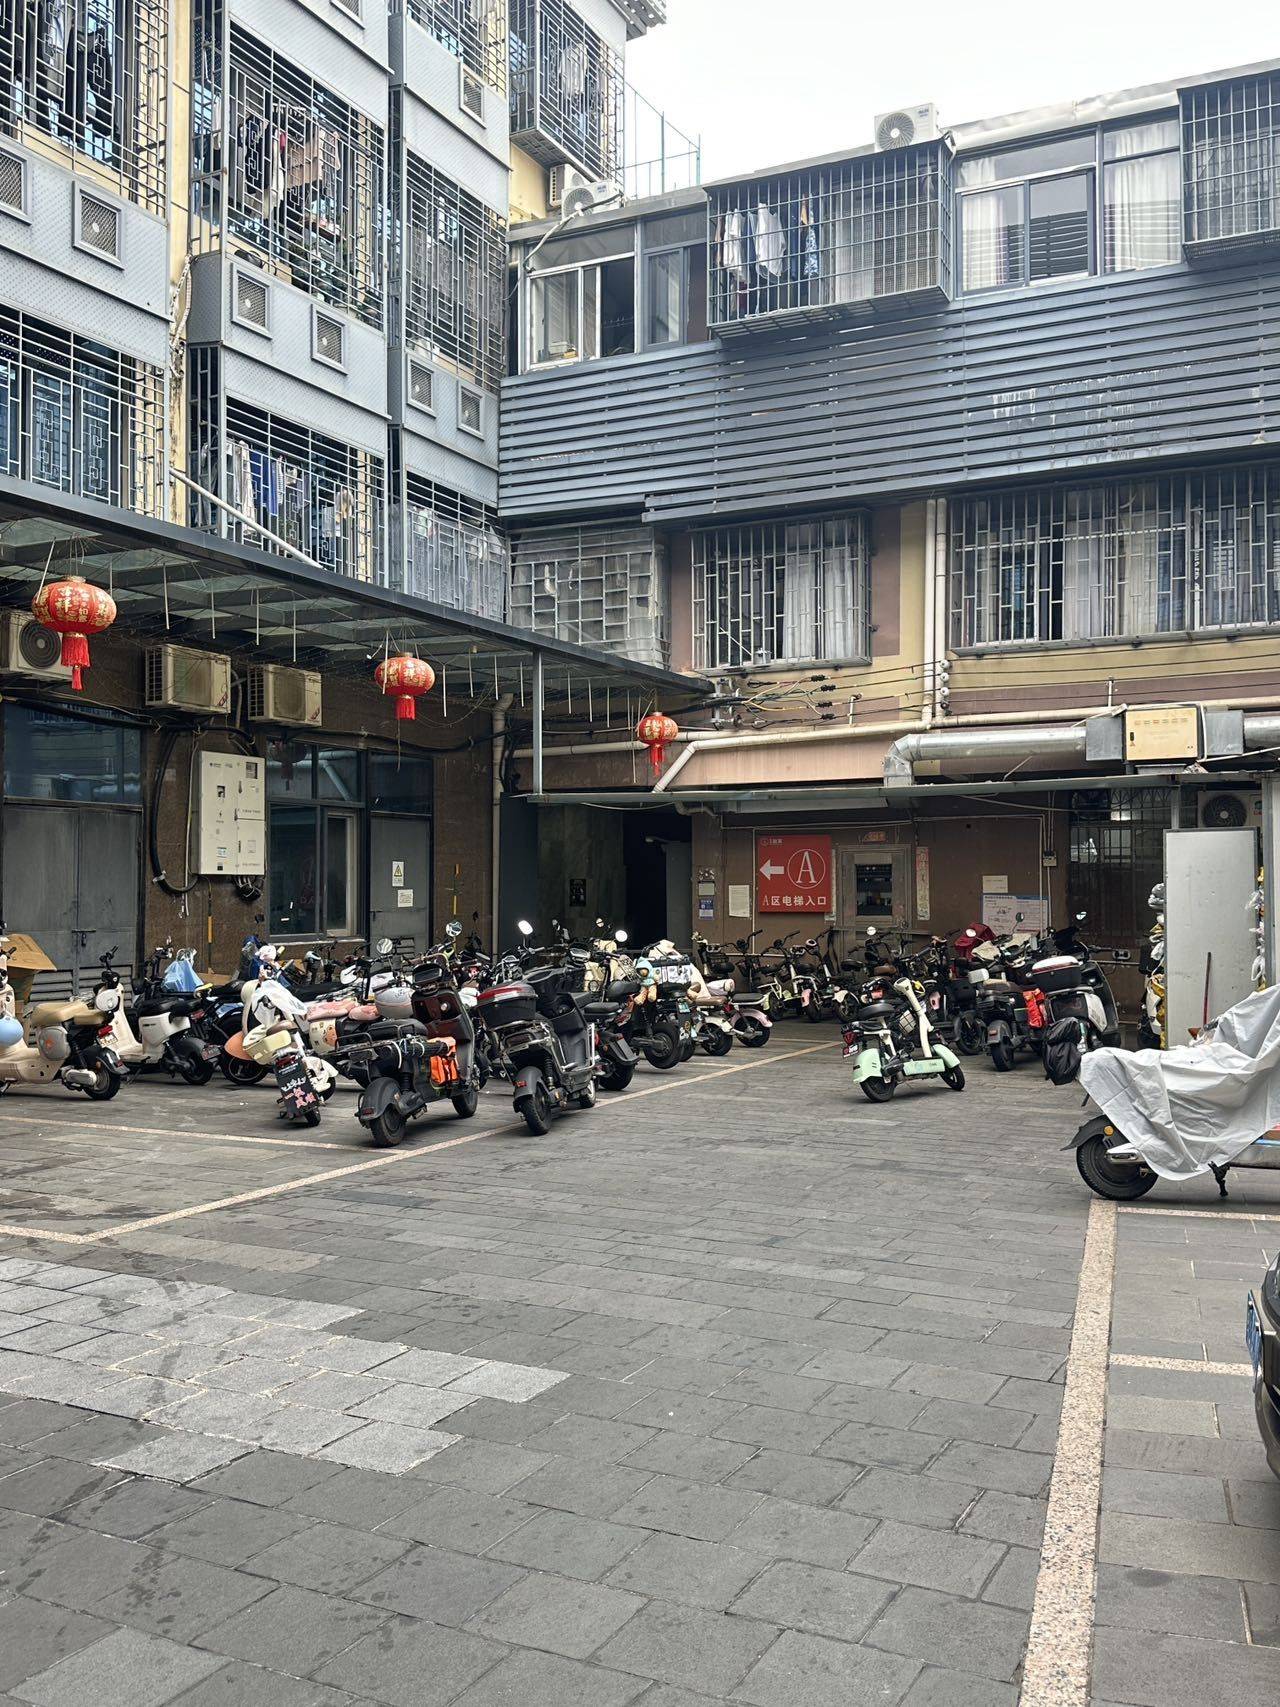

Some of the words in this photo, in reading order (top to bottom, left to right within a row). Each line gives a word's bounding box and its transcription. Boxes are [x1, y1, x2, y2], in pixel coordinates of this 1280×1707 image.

[796, 851, 817, 883] A
[762, 895, 827, 906] A区电梯入口
